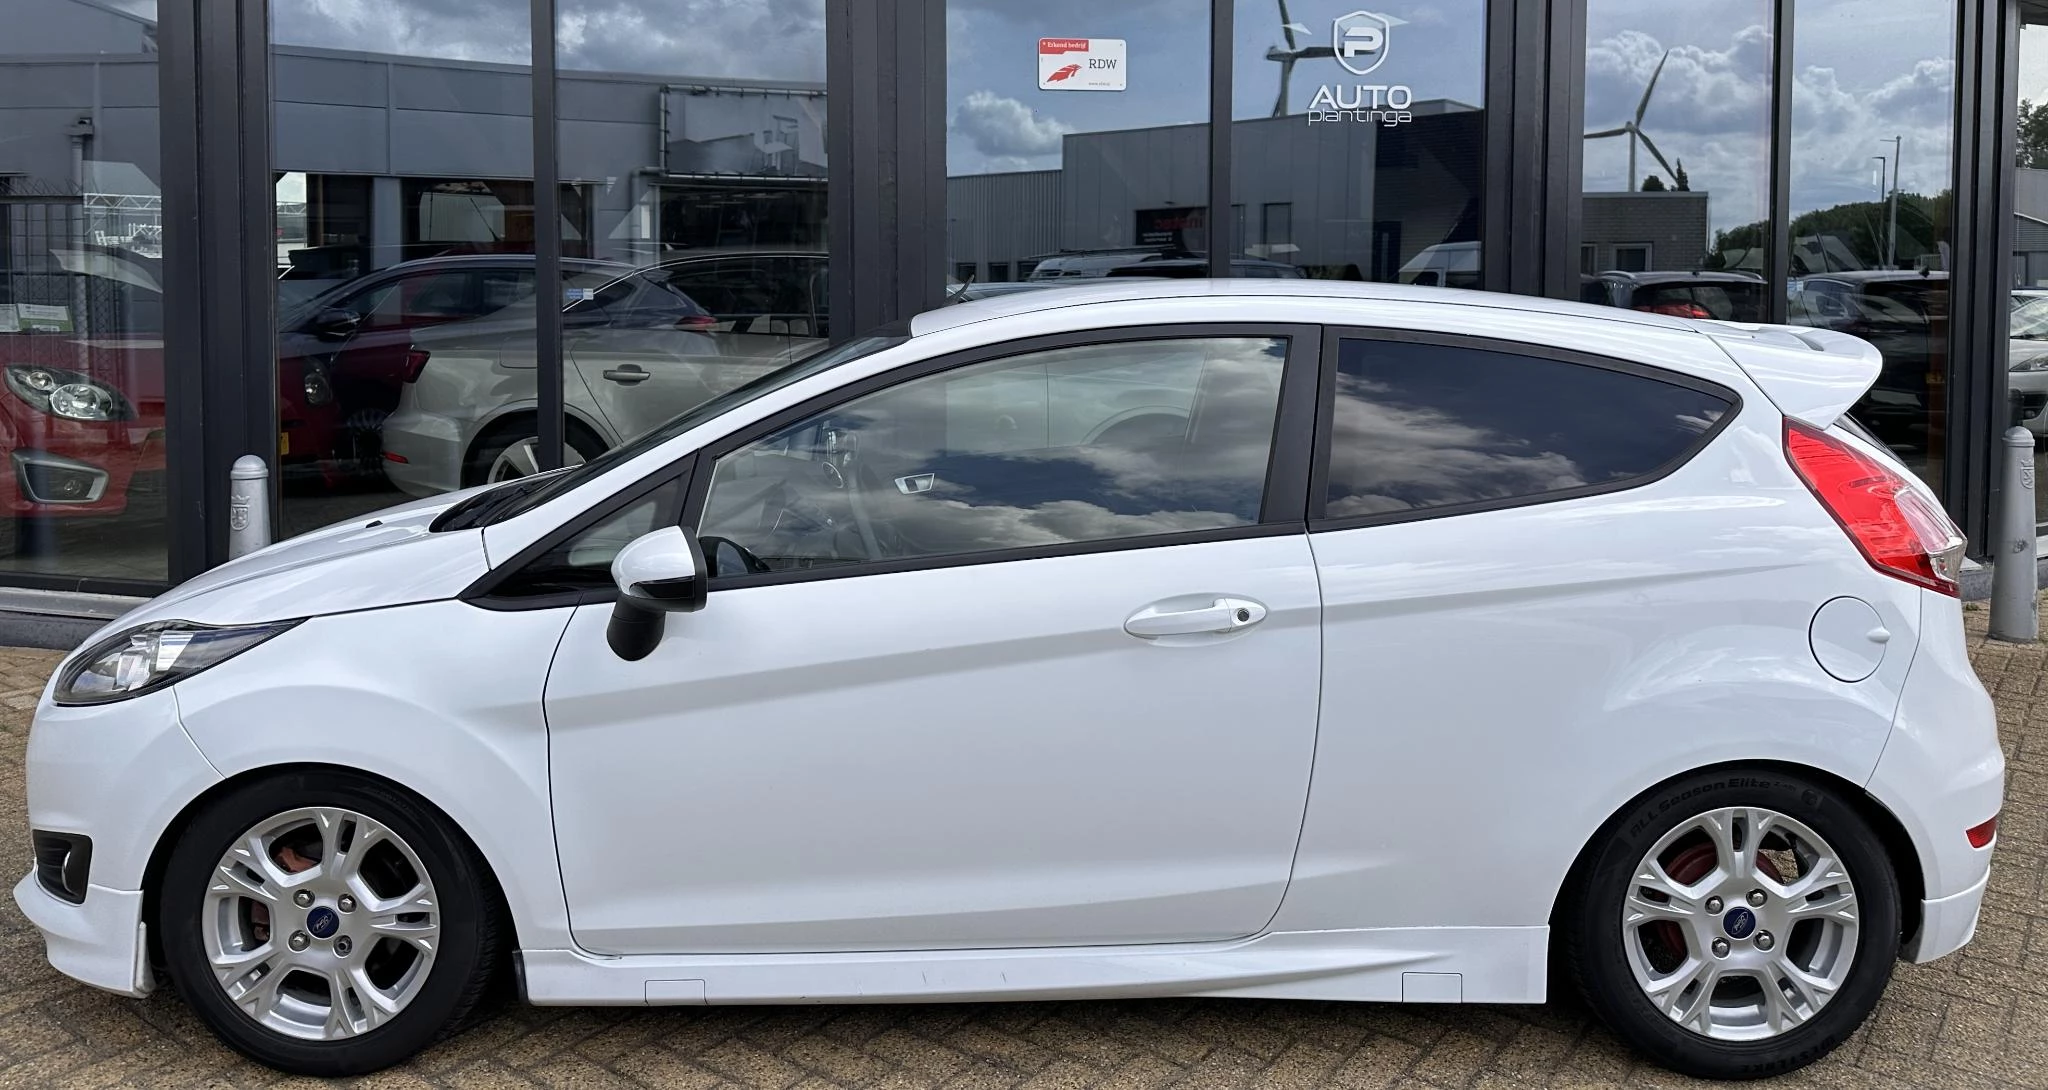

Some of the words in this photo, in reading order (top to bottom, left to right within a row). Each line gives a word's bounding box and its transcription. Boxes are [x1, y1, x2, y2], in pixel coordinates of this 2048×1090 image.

[1068, 41, 1087, 50] bedrijf
[1343, 26, 1384, 58] P
[1088, 58, 1118, 70] RDW
[1308, 84, 1412, 110] AUTO
[1307, 107, 1412, 127] plantinga
[1658, 781, 1726, 813] Season
[1727, 777, 1770, 790] Elite
